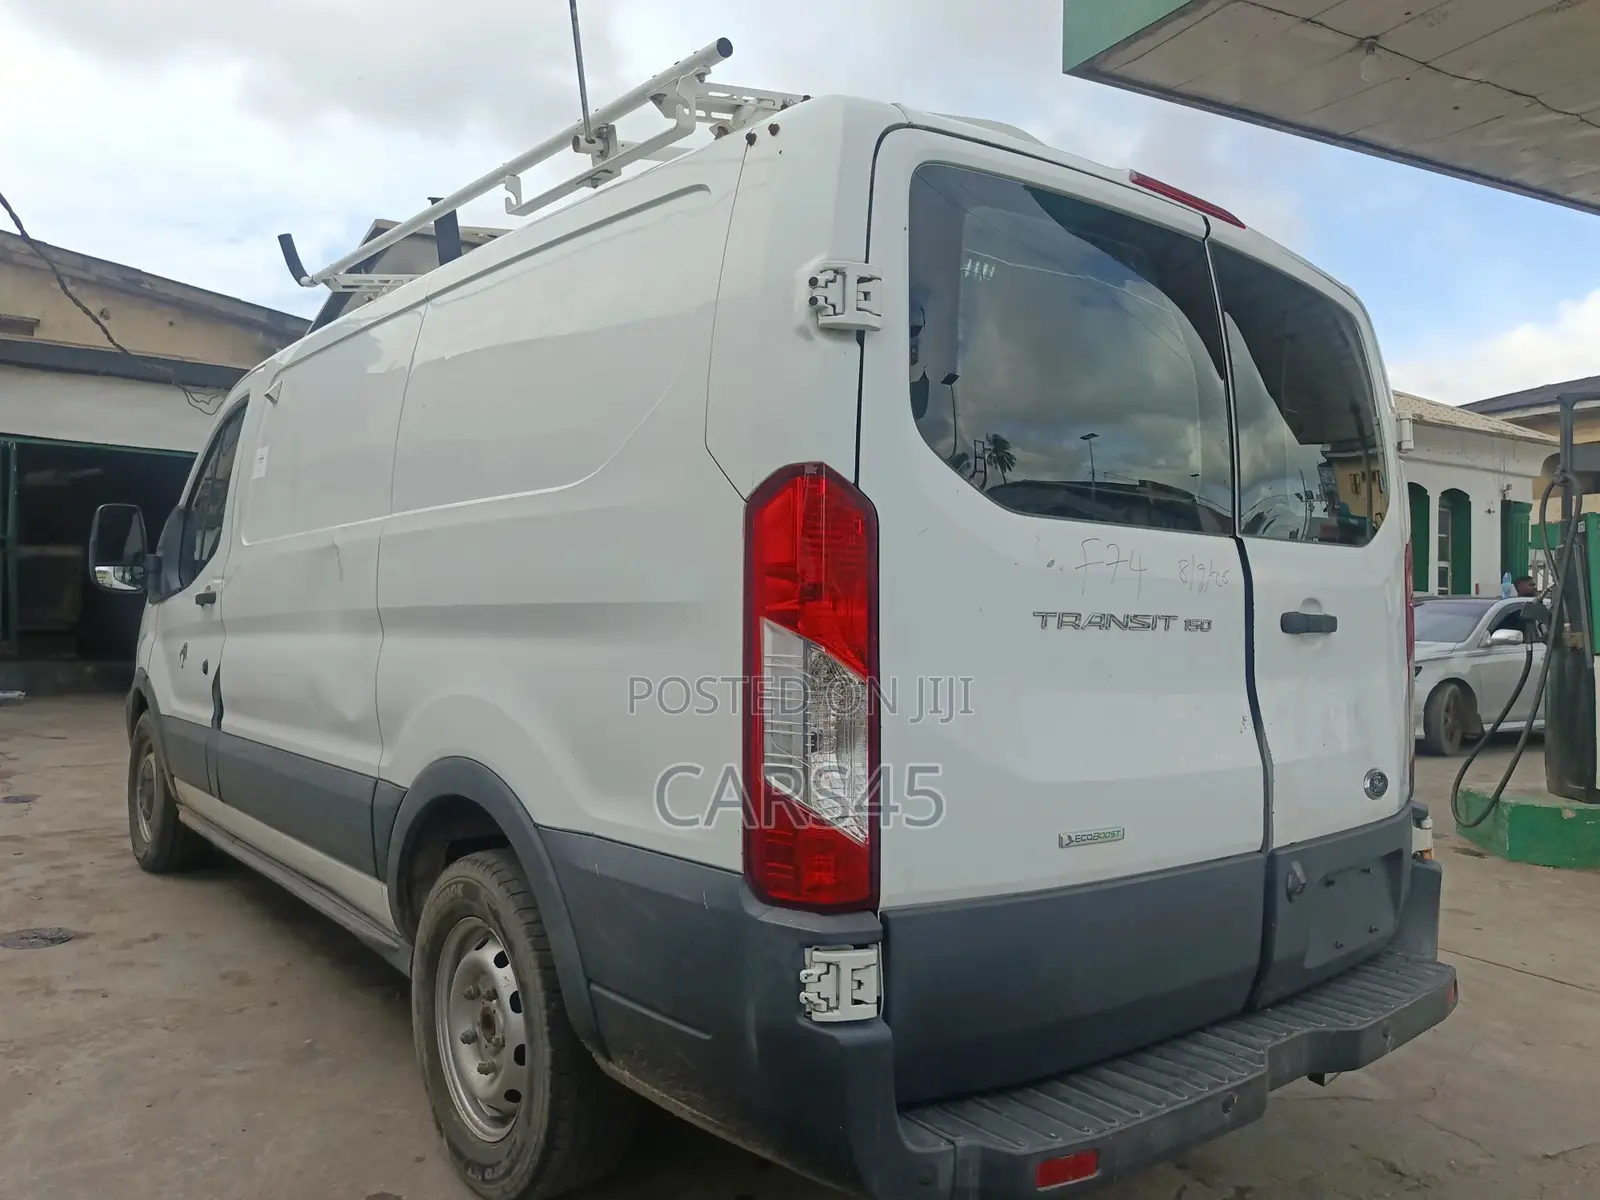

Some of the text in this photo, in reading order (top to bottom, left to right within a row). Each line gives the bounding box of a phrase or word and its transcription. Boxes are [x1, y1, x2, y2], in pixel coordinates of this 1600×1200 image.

[1032, 611, 1213, 633] TRANSIT 150
[1074, 829, 1122, 843] ECOBOOST
